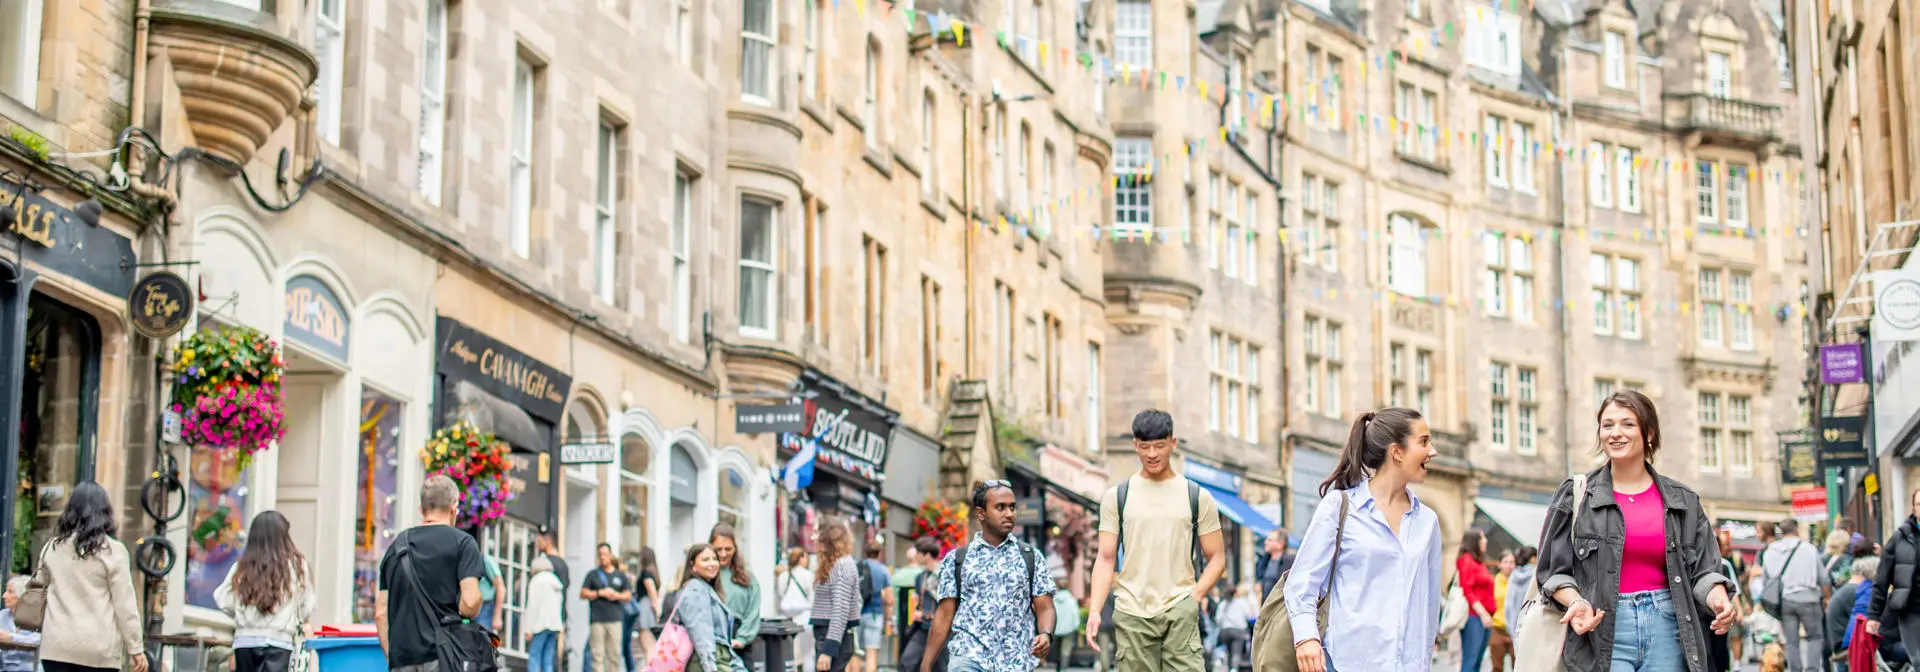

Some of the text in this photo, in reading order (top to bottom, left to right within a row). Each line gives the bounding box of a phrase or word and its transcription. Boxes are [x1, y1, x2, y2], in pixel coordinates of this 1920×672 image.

[0, 188, 56, 248] ALL
[313, 293, 345, 347] SKY
[480, 348, 548, 400] CAVANAGH
[812, 407, 887, 466] SCOTLAND
